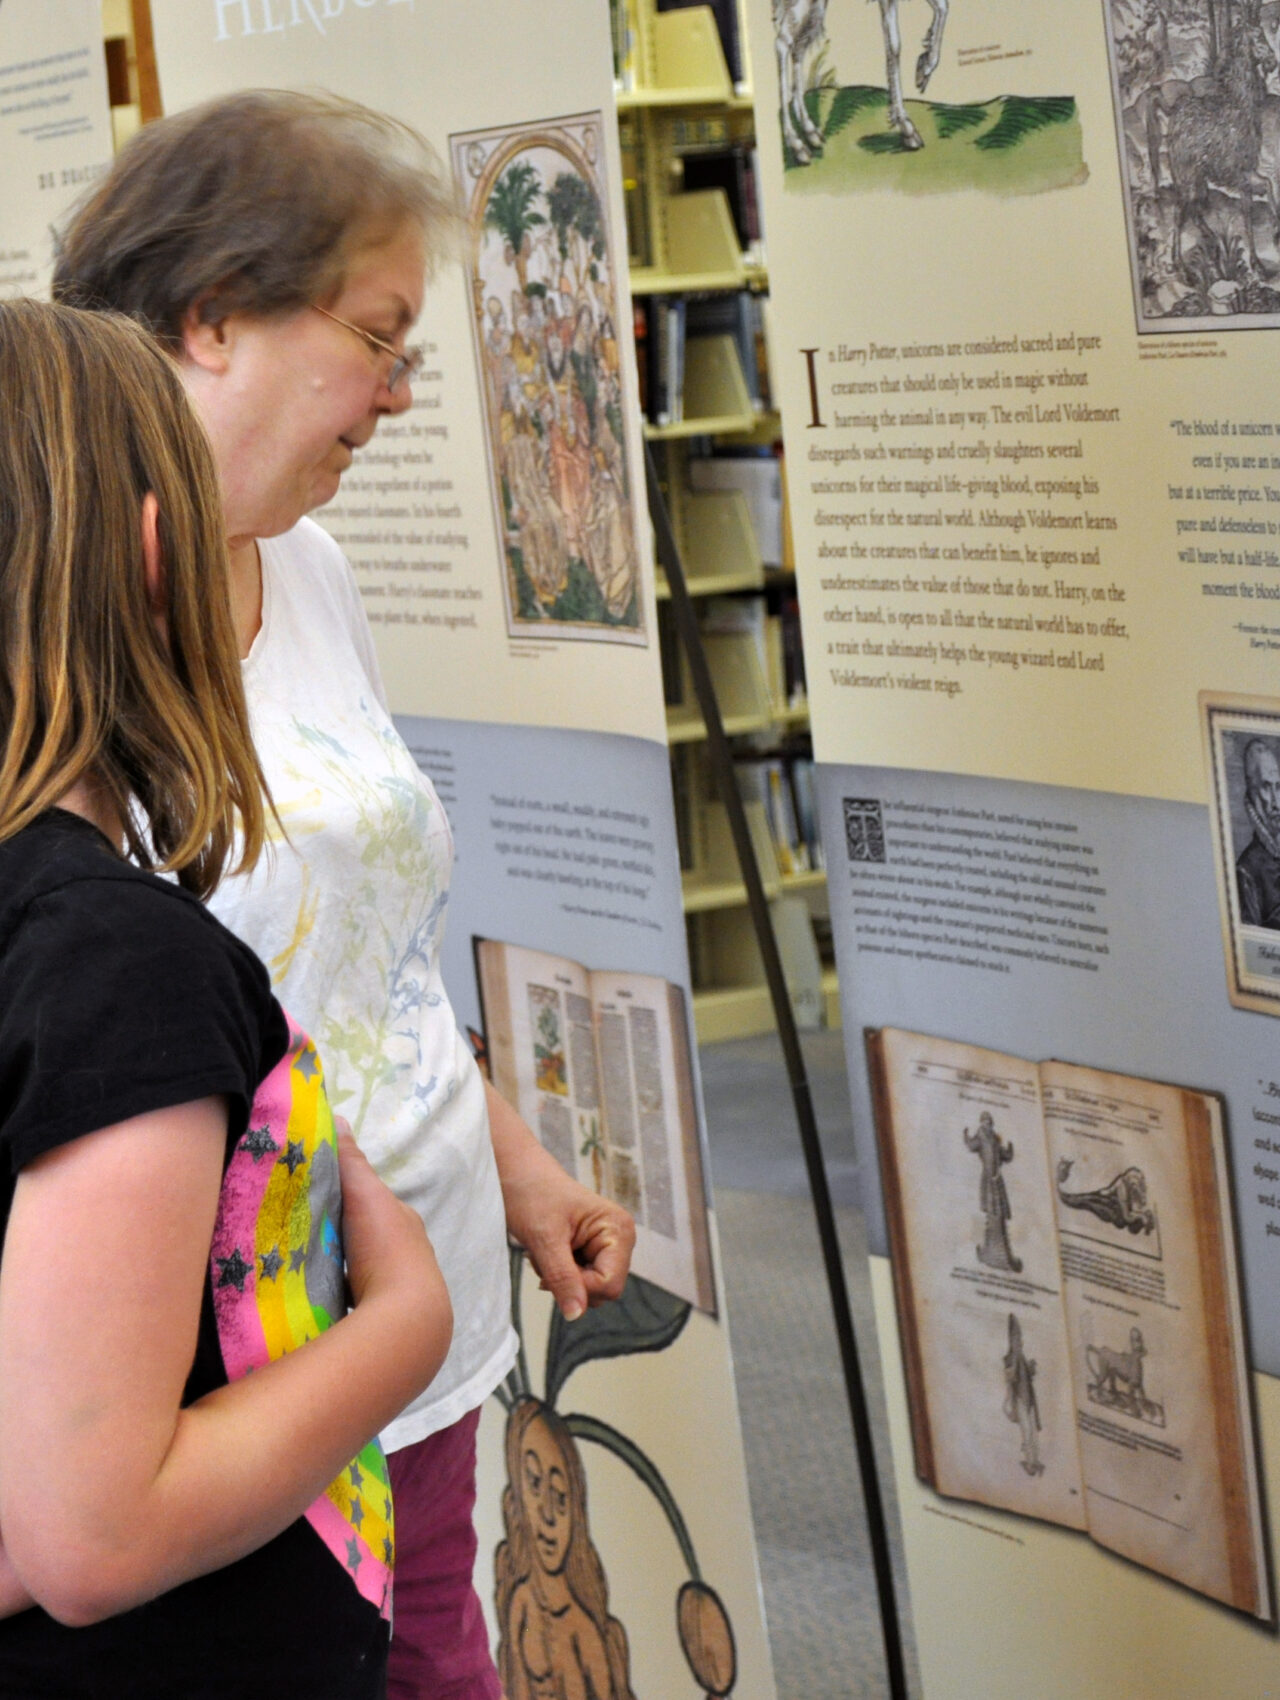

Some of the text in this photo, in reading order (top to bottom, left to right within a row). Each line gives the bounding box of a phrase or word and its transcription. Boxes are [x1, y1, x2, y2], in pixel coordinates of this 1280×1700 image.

[838, 345, 867, 366] Harry
[900, 344, 946, 359] unicorns
[946, 343, 962, 356] are
[963, 336, 1019, 355] considered
[1020, 334, 1054, 353] sacred
[1056, 333, 1076, 351] and
[1076, 336, 1101, 356] pure
[830, 369, 1089, 396] creatures that should only be used in magic without
[834, 411, 879, 432] harming
[879, 409, 897, 427] the
[899, 407, 934, 426] animal
[935, 412, 947, 425] in
[948, 412, 966, 430] any
[990, 406, 1013, 424] The
[1014, 406, 1034, 423] evil
[1035, 405, 1062, 423] Lord
[1062, 405, 1120, 423] Voldemort
[863, 442, 887, 460] such
[888, 447, 935, 465] warnings
[936, 441, 956, 459] and
[956, 440, 991, 464] cruelly
[993, 440, 1045, 464] slaughters
[1046, 439, 1083, 459] several
[810, 481, 858, 495] unicorns
[859, 475, 875, 493] for
[876, 475, 902, 493] their
[904, 475, 943, 499] magical
[1082, 475, 1100, 495] his
[869, 509, 885, 526] for
[887, 509, 904, 526] the
[906, 510, 943, 527] natural
[979, 510, 1027, 534] Although
[1026, 511, 1084, 529] Voldemort
[1084, 512, 1118, 530] learns
[817, 541, 848, 559] about
[850, 541, 868, 558] the
[869, 546, 918, 559] creatures
[918, 542, 940, 560] that
[941, 547, 961, 560] can
[961, 543, 998, 561] benefit
[1024, 544, 1039, 563] he
[1040, 550, 1079, 569] ignores
[1080, 546, 1101, 565] and
[820, 574, 901, 592] underestimates
[902, 576, 920, 592] the
[921, 577, 948, 593] value
[949, 578, 961, 594] of
[962, 578, 991, 595] those
[992, 579, 1014, 597] that
[1016, 580, 1031, 597] do
[1091, 587, 1107, 601] on
[1107, 583, 1126, 602] the
[823, 606, 853, 623] other
[887, 612, 897, 624] is
[898, 612, 925, 630] open
[925, 613, 938, 626] to
[939, 611, 953, 627] all
[953, 611, 976, 628] that
[977, 612, 995, 629] the
[997, 614, 1034, 632] natural
[1035, 616, 1065, 634] world
[1065, 616, 1085, 635] has
[1086, 622, 1100, 636] to
[835, 642, 860, 655] trait
[861, 639, 884, 656] that
[939, 643, 967, 666] helps
[968, 645, 986, 662] the
[986, 650, 1020, 670] young
[1019, 649, 1056, 668] wizard
[1056, 650, 1077, 669] end
[1077, 651, 1105, 672] Lord
[896, 673, 932, 692] violent
